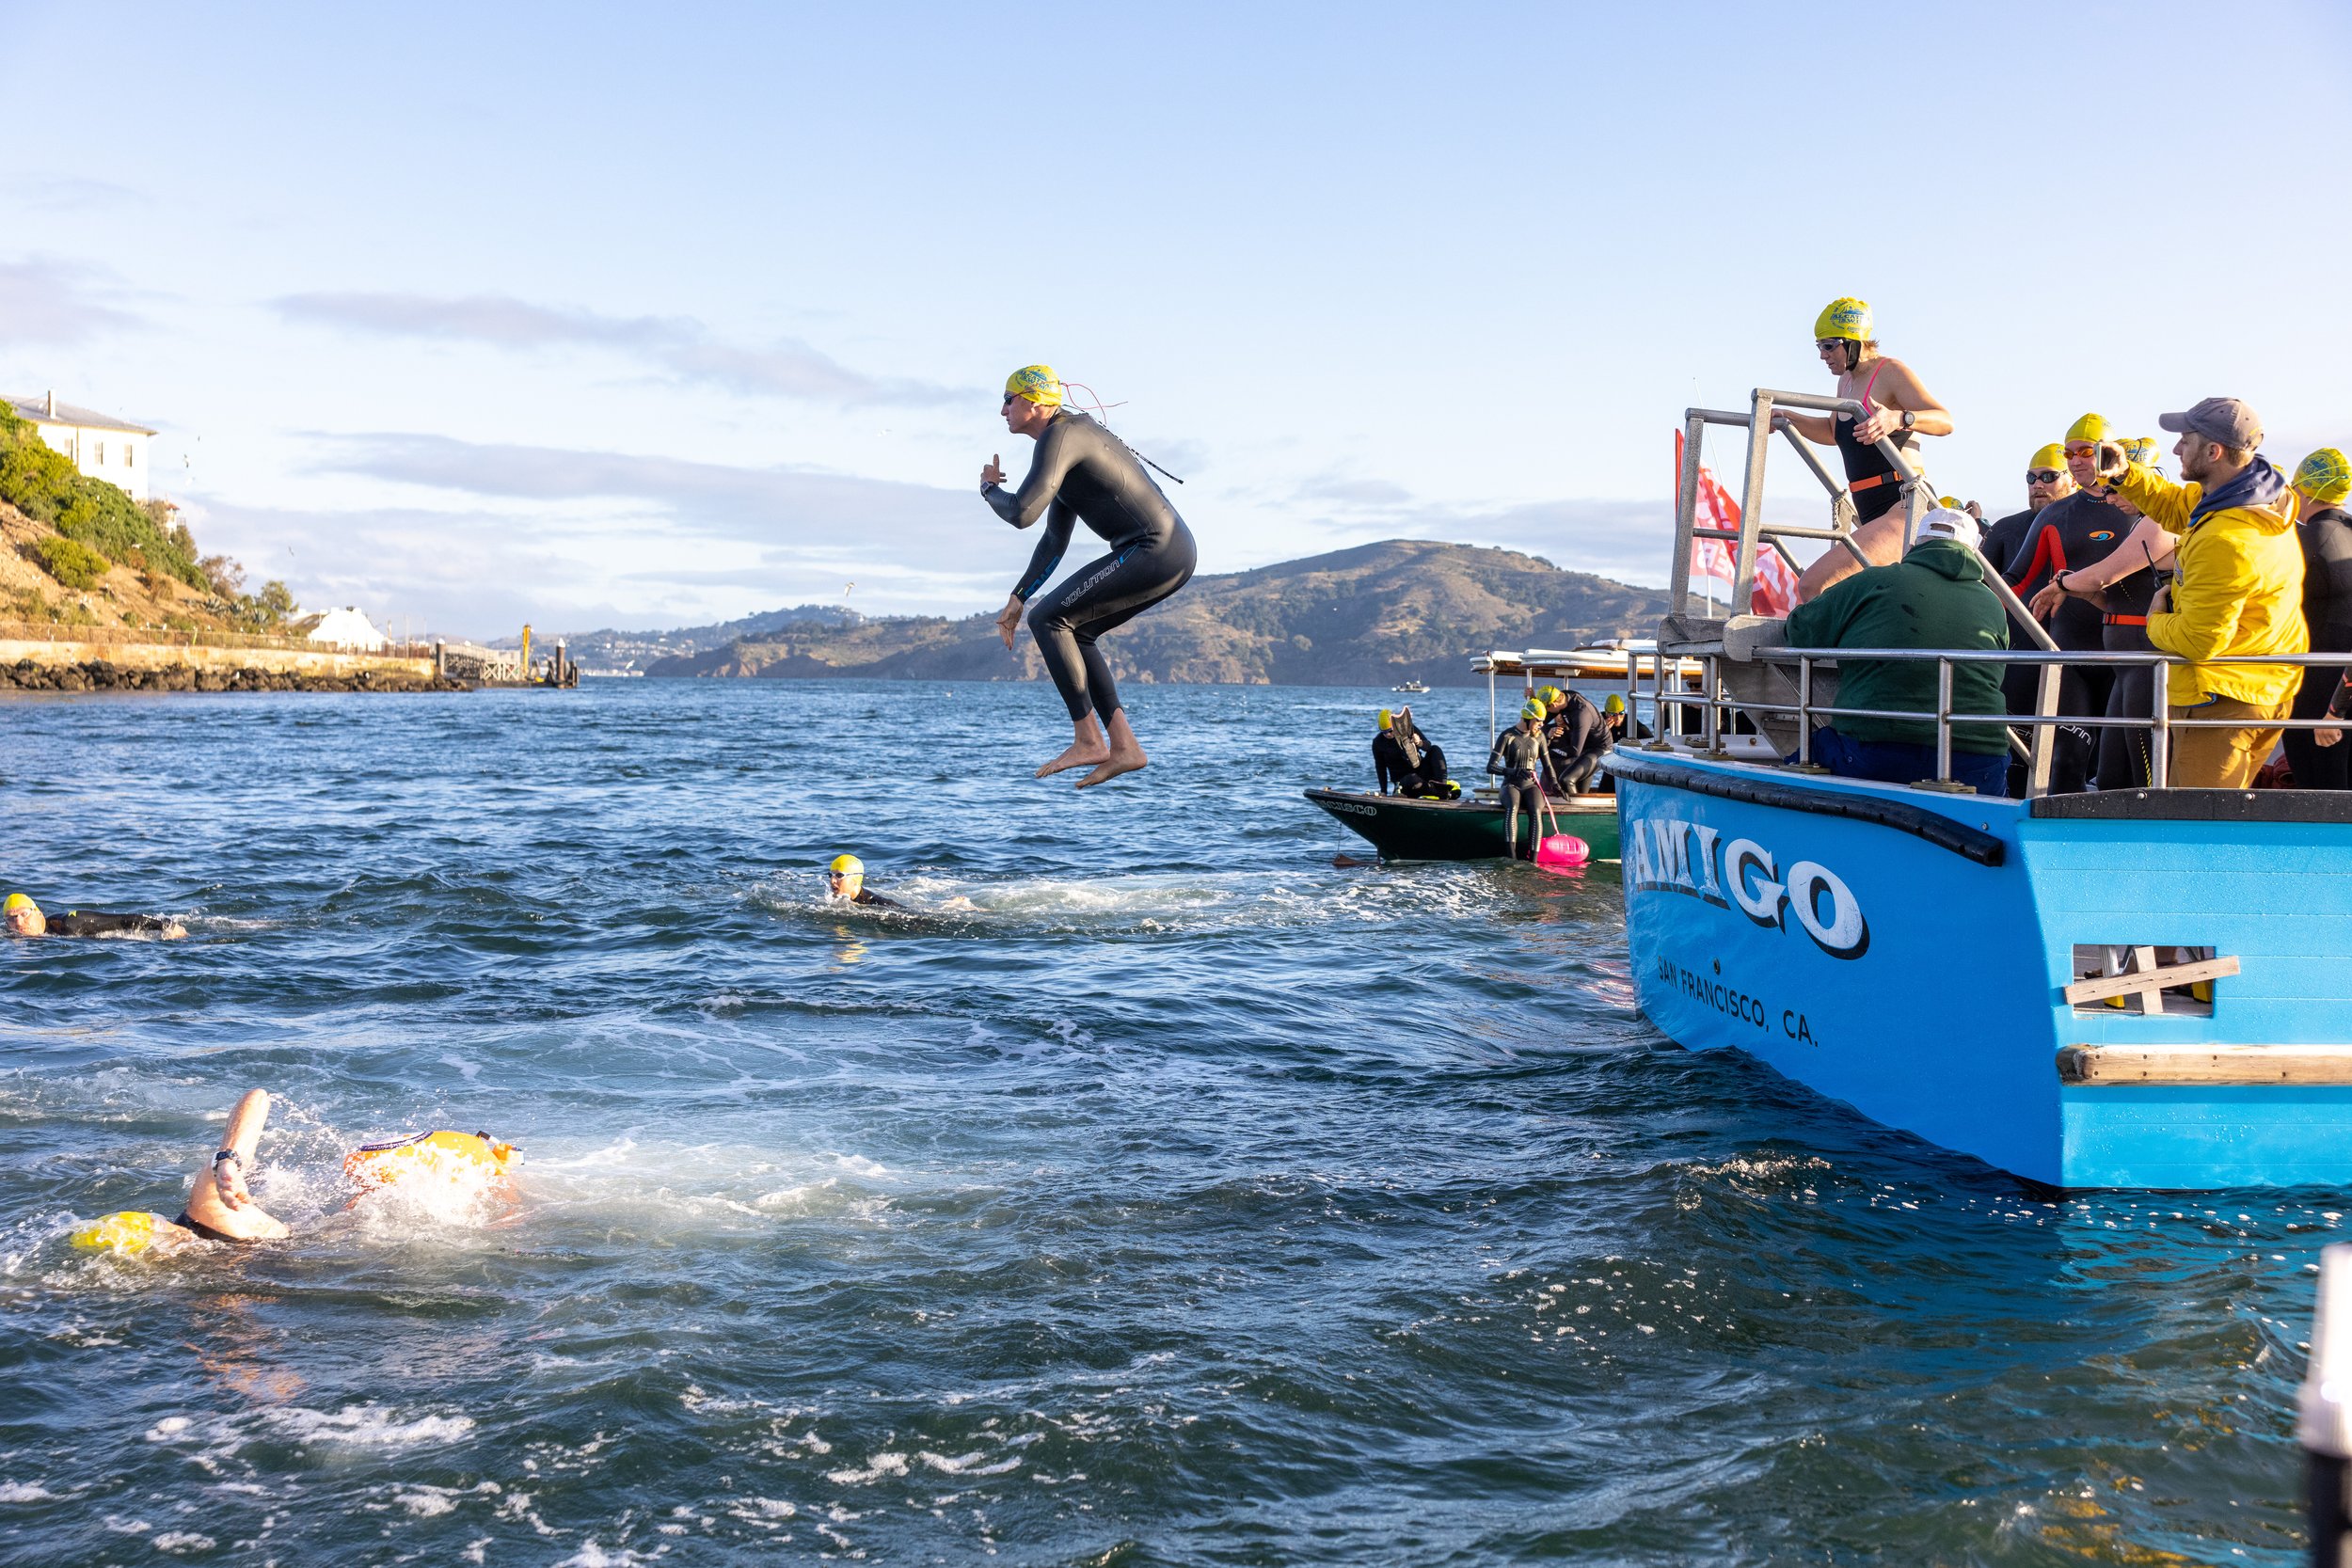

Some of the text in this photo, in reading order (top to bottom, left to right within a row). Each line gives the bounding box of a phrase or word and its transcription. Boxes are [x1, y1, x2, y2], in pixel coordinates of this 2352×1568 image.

[1632, 818, 1869, 960] AMIGO
[1658, 955, 1820, 1047] SAN FRANCISCO, CA.
